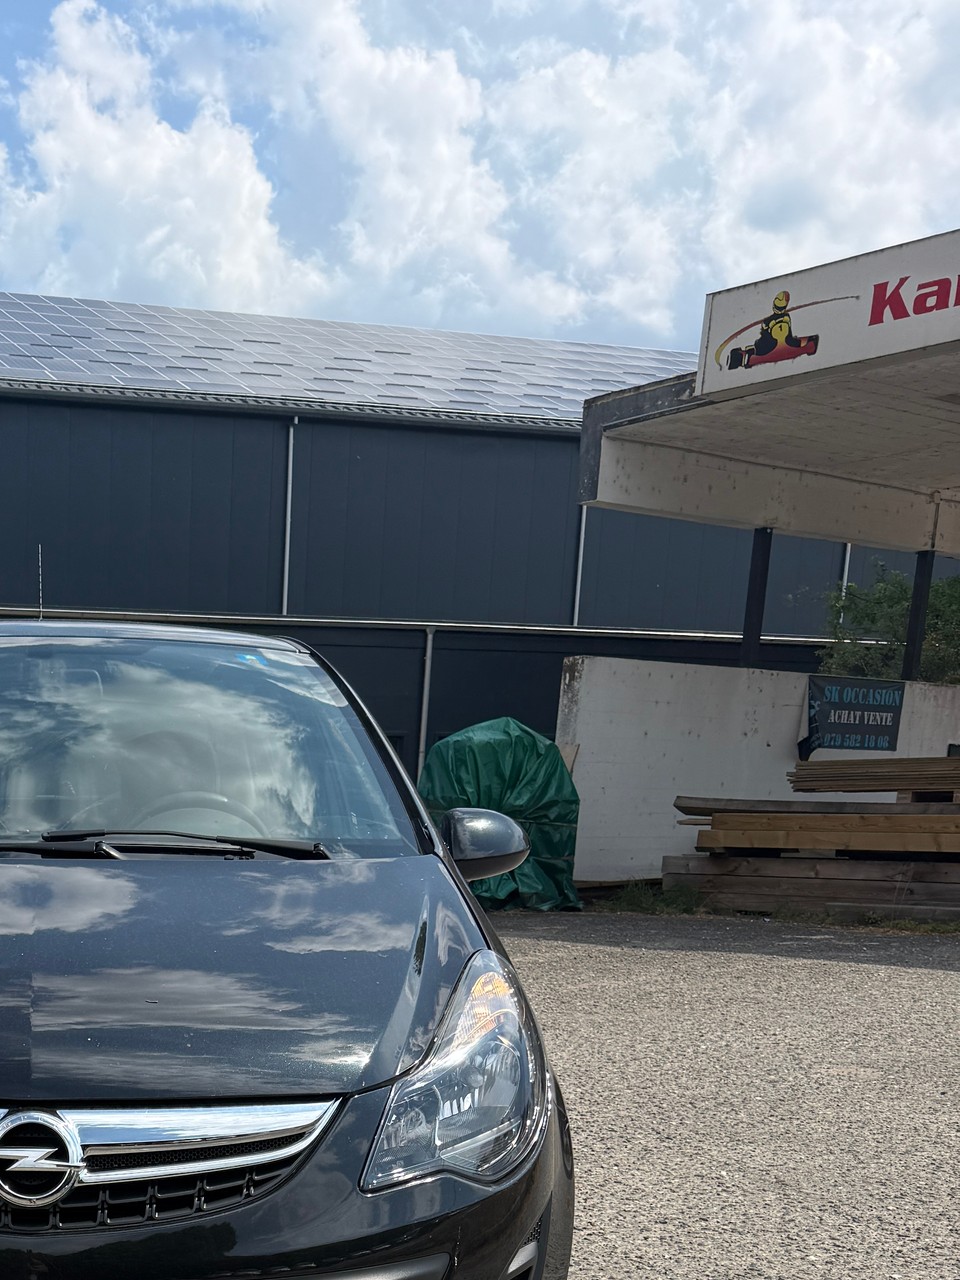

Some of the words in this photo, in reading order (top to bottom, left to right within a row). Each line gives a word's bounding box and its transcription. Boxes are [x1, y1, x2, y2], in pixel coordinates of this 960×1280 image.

[868, 274, 960, 327] Ka
[823, 685, 841, 702] SK
[843, 686, 902, 706] OCCASION
[828, 709, 861, 724] ACHAT
[864, 711, 894, 726] VENTE
[823, 733, 841, 746] 079
